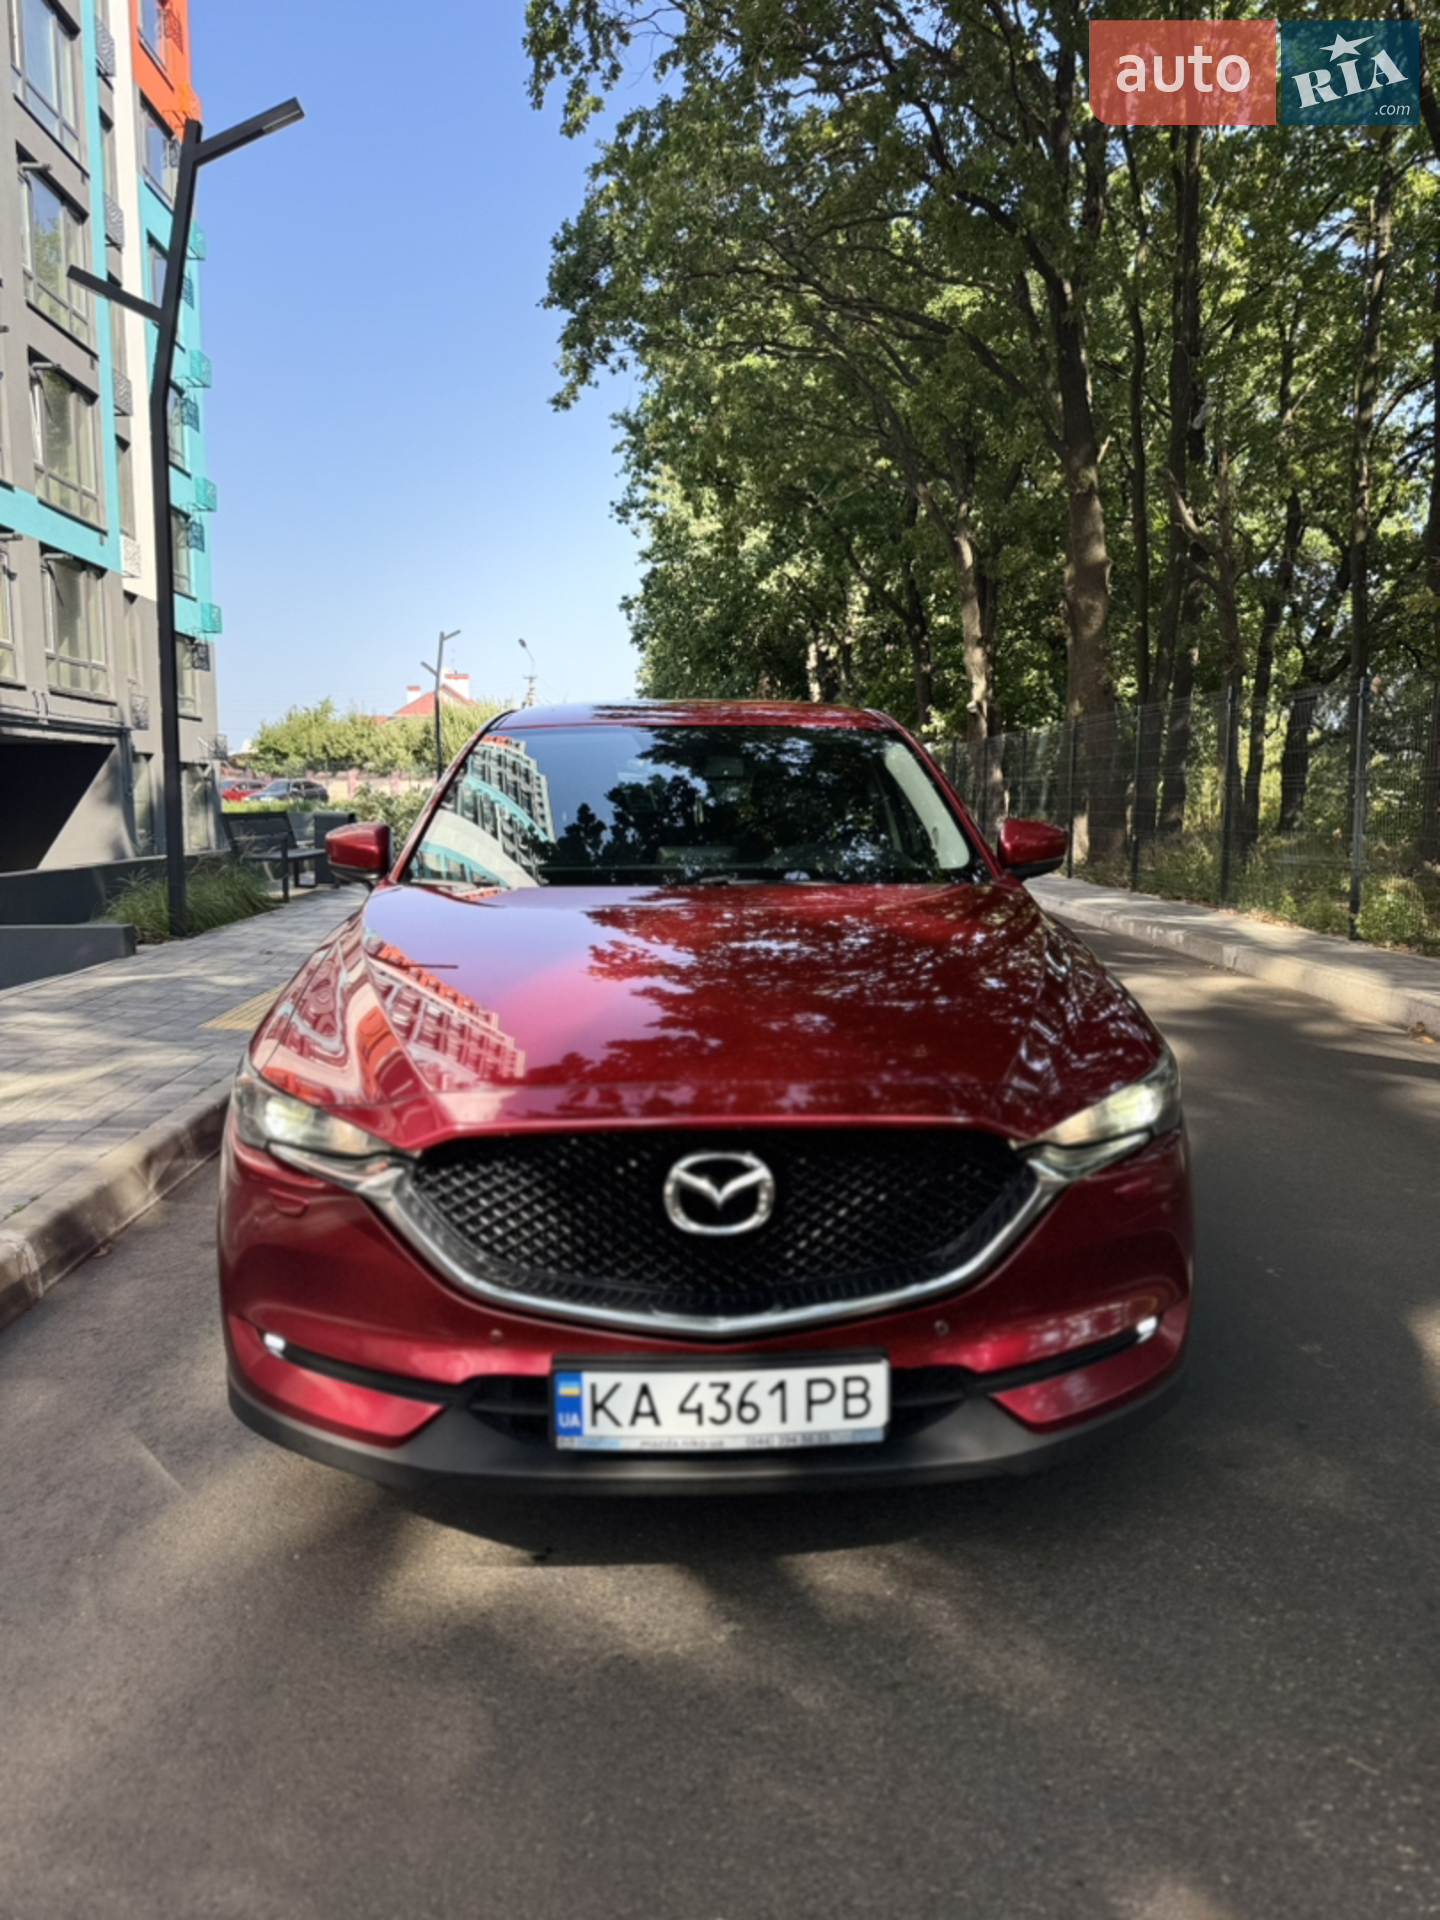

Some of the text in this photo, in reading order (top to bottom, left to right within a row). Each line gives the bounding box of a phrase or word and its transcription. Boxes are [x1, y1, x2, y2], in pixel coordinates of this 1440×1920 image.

[590, 1375, 872, 1427] KA 4361 PB
[558, 1413, 581, 1427] UA
